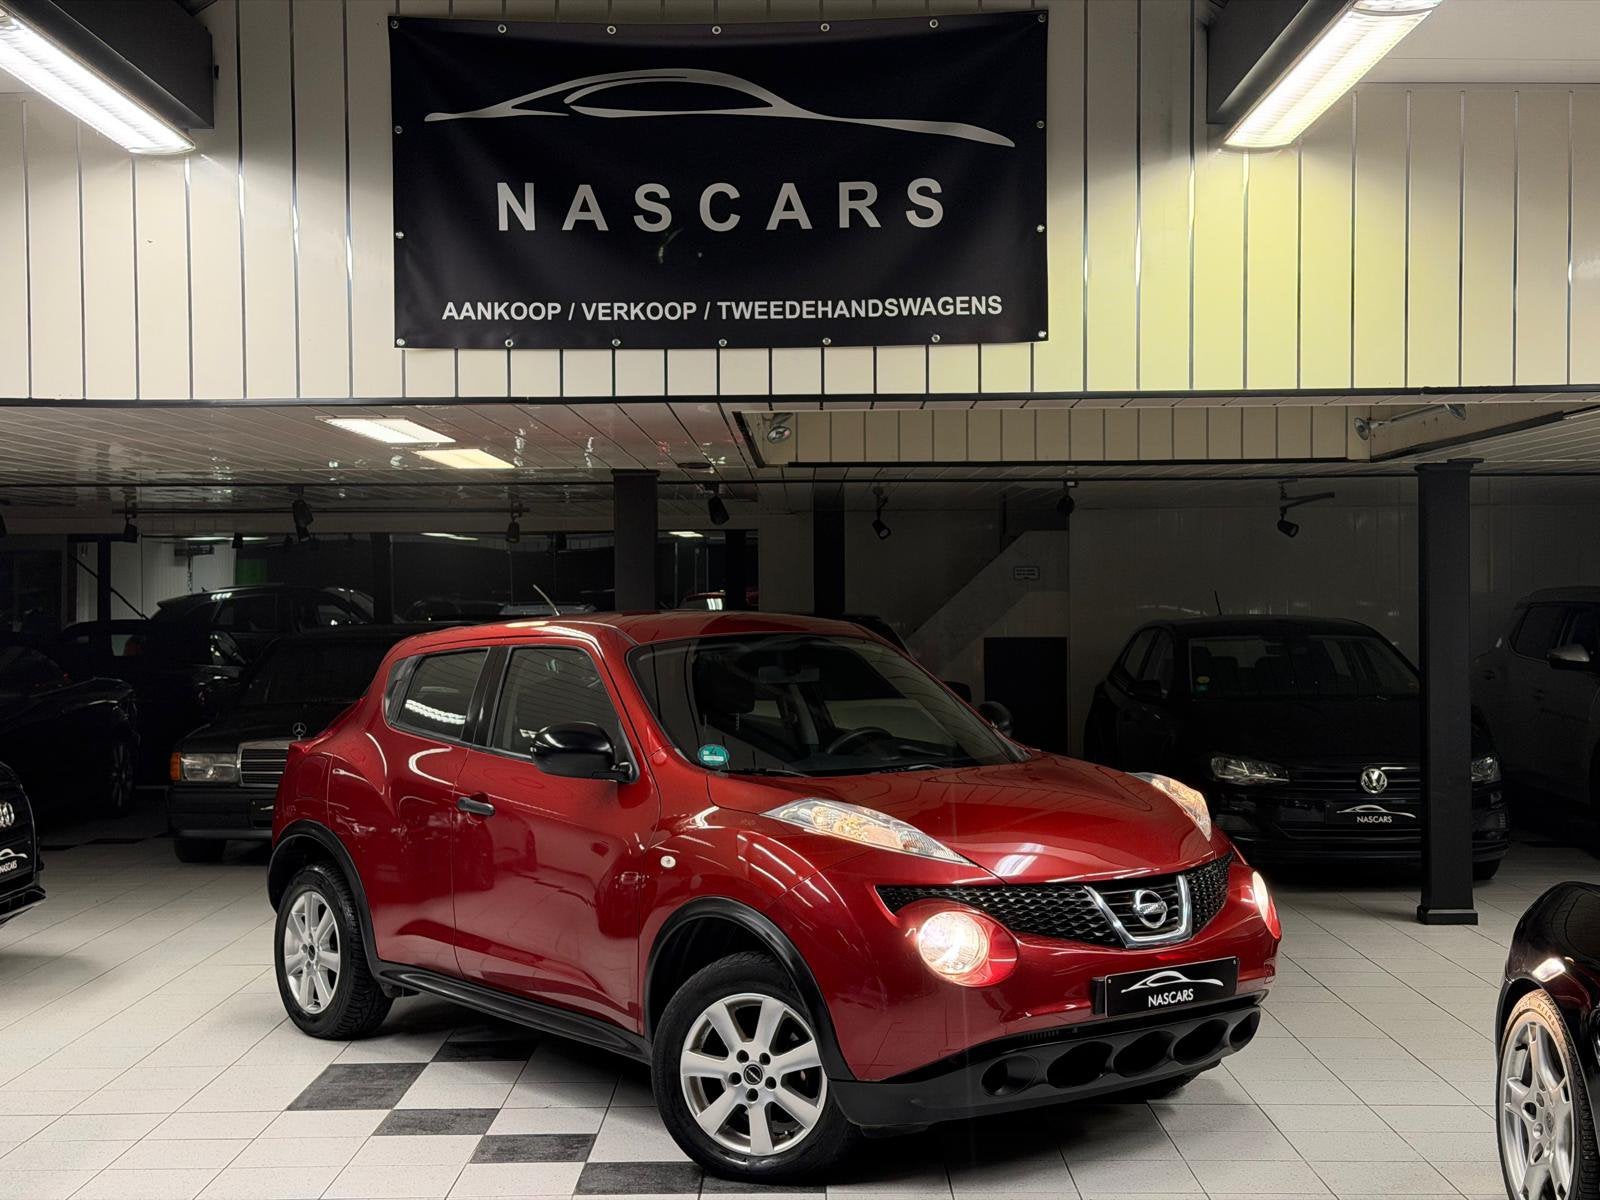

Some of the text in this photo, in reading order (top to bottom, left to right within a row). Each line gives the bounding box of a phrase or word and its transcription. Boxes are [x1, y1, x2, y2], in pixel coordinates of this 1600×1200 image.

[496, 177, 945, 233] NASCARS
[441, 295, 1003, 321] AANKOOP / VERKOOP / TWEEDEHANDSWAGENS
[1356, 815, 1393, 823] NASCARS
[1147, 988, 1194, 1008] NASCARS
